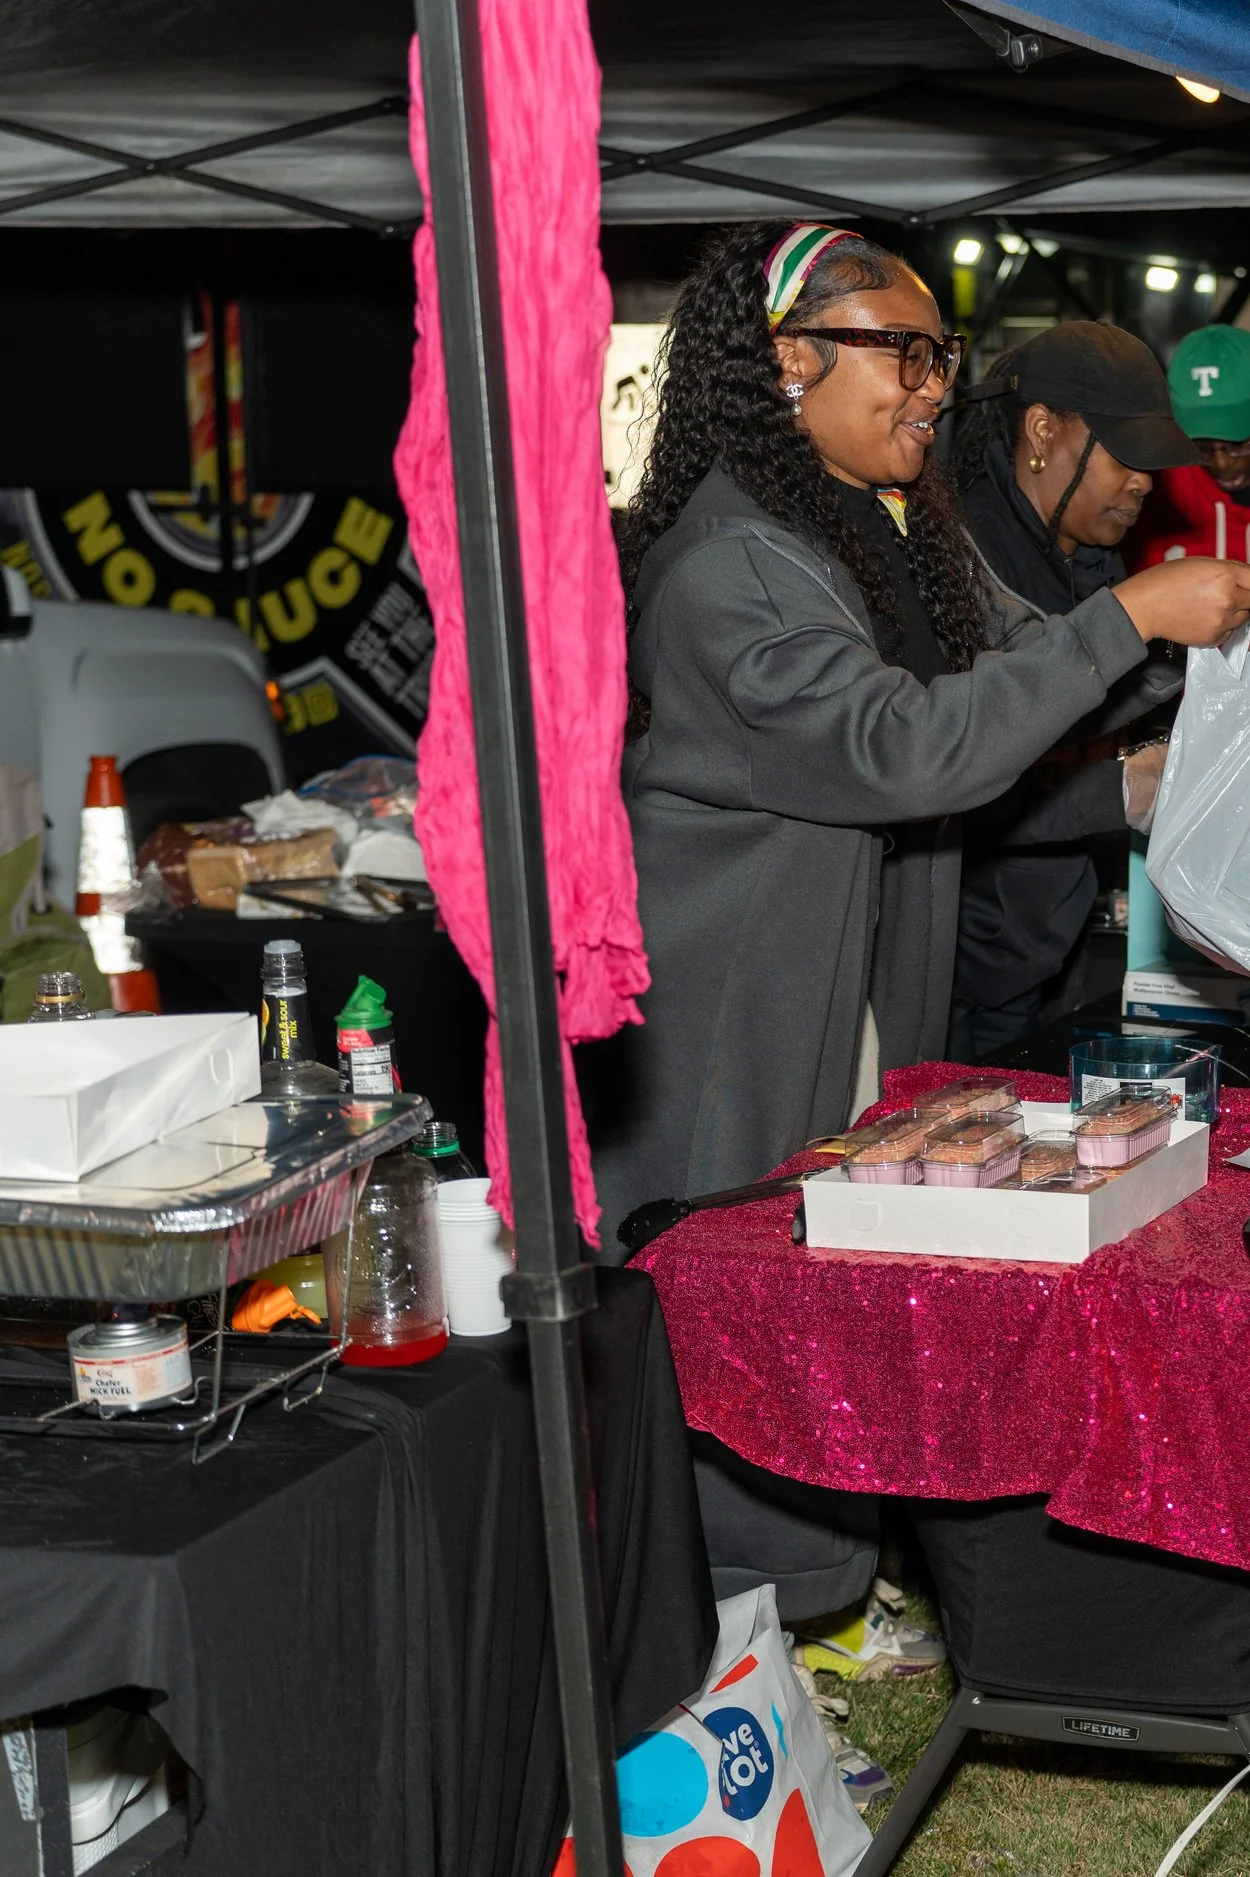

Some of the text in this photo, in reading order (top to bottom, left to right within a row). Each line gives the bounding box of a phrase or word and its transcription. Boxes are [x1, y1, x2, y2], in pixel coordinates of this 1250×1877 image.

[1191, 366, 1219, 397] T
[63, 491, 156, 607] NO
[279, 1000, 288, 1020] sour
[289, 1020, 298, 1039] mix
[279, 1029, 290, 1060] sweet
[89, 1387, 131, 1395] WICK FUEL
[1071, 1720, 1131, 1738] LIFETIME
